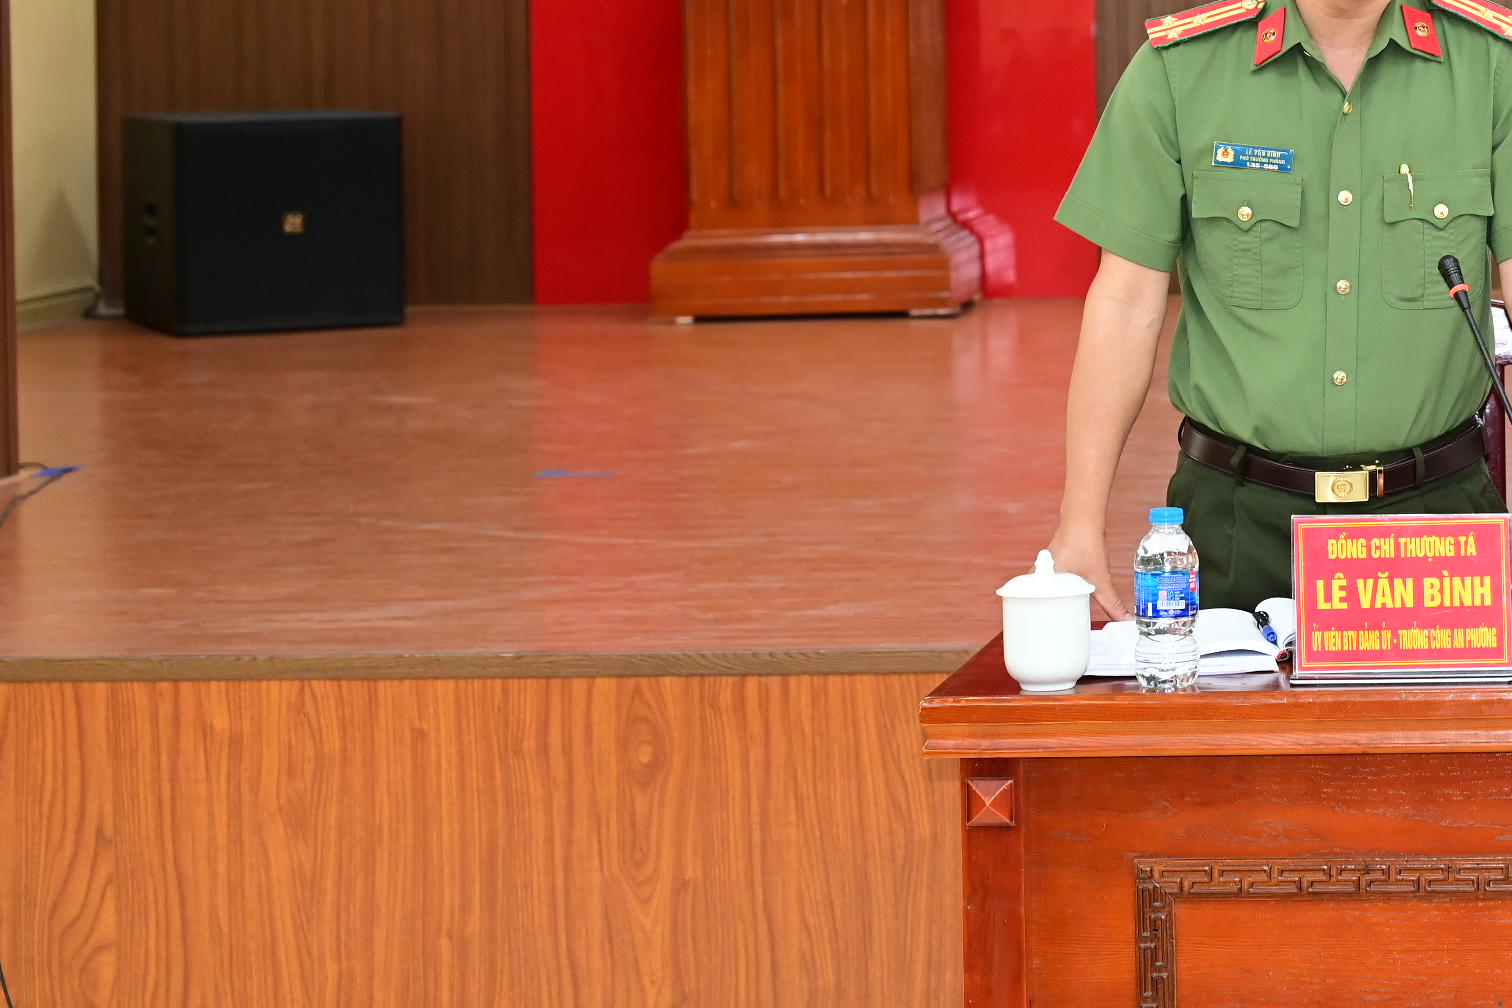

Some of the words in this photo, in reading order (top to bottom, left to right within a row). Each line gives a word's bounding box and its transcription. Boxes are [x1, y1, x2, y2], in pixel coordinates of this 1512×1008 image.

[1371, 534, 1394, 558] CHÍ
[1398, 535, 1454, 561] THƯỢNG
[1458, 532, 1476, 556] TÁ
[1316, 572, 1348, 610] LÊ
[1356, 571, 1414, 609] VĂN
[1423, 569, 1492, 608] BÌNH
[1312, 623, 1322, 651] ỦY
[1324, 627, 1341, 651] VIÊN
[1343, 631, 1357, 650] BTV
[1359, 622, 1380, 650] ĐẢNG
[1382, 622, 1391, 650] ỦY
[1398, 621, 1429, 649] TRƯỞNG
[1430, 625, 1451, 649] CÔNG
[1453, 629, 1464, 648] AN
[1466, 623, 1497, 648] PHƯỜNG
